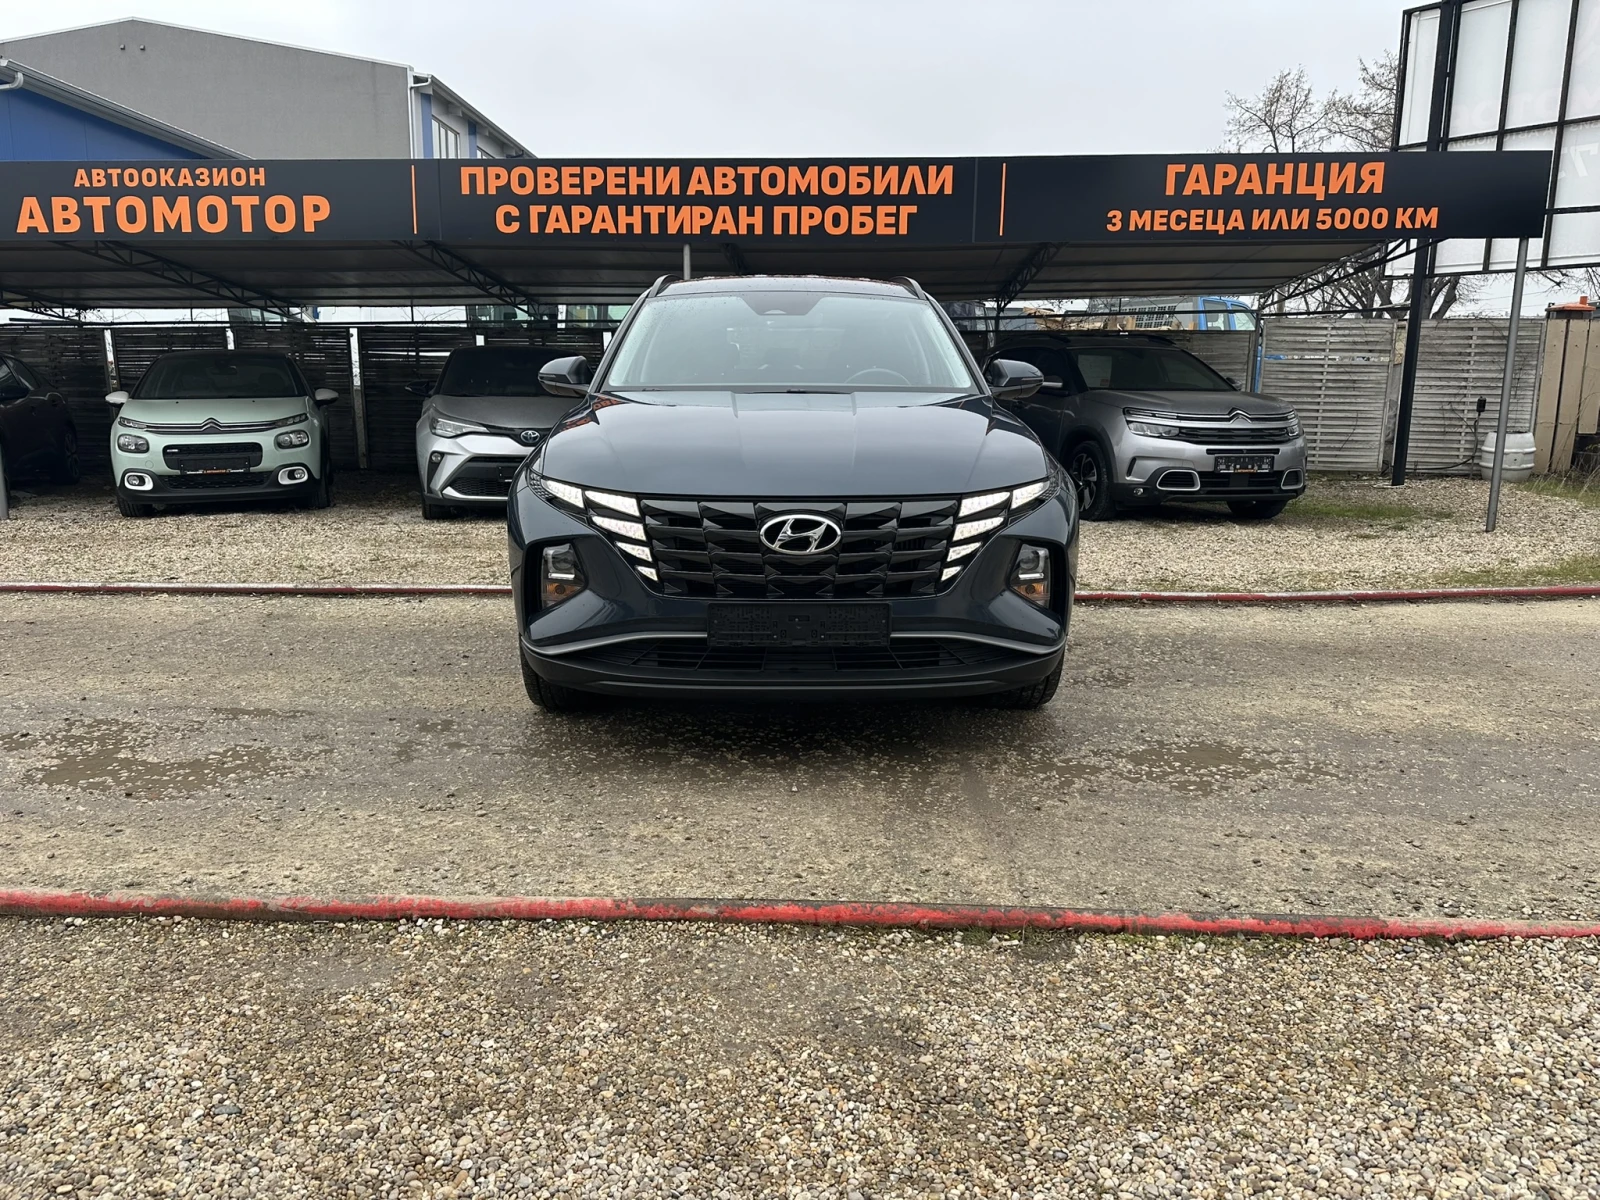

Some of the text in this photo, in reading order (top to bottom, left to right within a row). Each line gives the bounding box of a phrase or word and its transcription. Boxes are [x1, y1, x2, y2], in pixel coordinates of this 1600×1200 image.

[74, 168, 266, 188] АВТООКАЗИОН
[460, 164, 954, 196] ПРОВЕРЕНИ АВТОМОБИЛИ
[1165, 161, 1385, 201] ГАРАНЦИЯ
[16, 194, 331, 234] АВТОМОТОР
[495, 204, 918, 236] С ГАРАНТИРАН ПРОБЕГ
[1106, 207, 1439, 236] 3 МЕСЕЦА ИЛИ 5000 КМ
